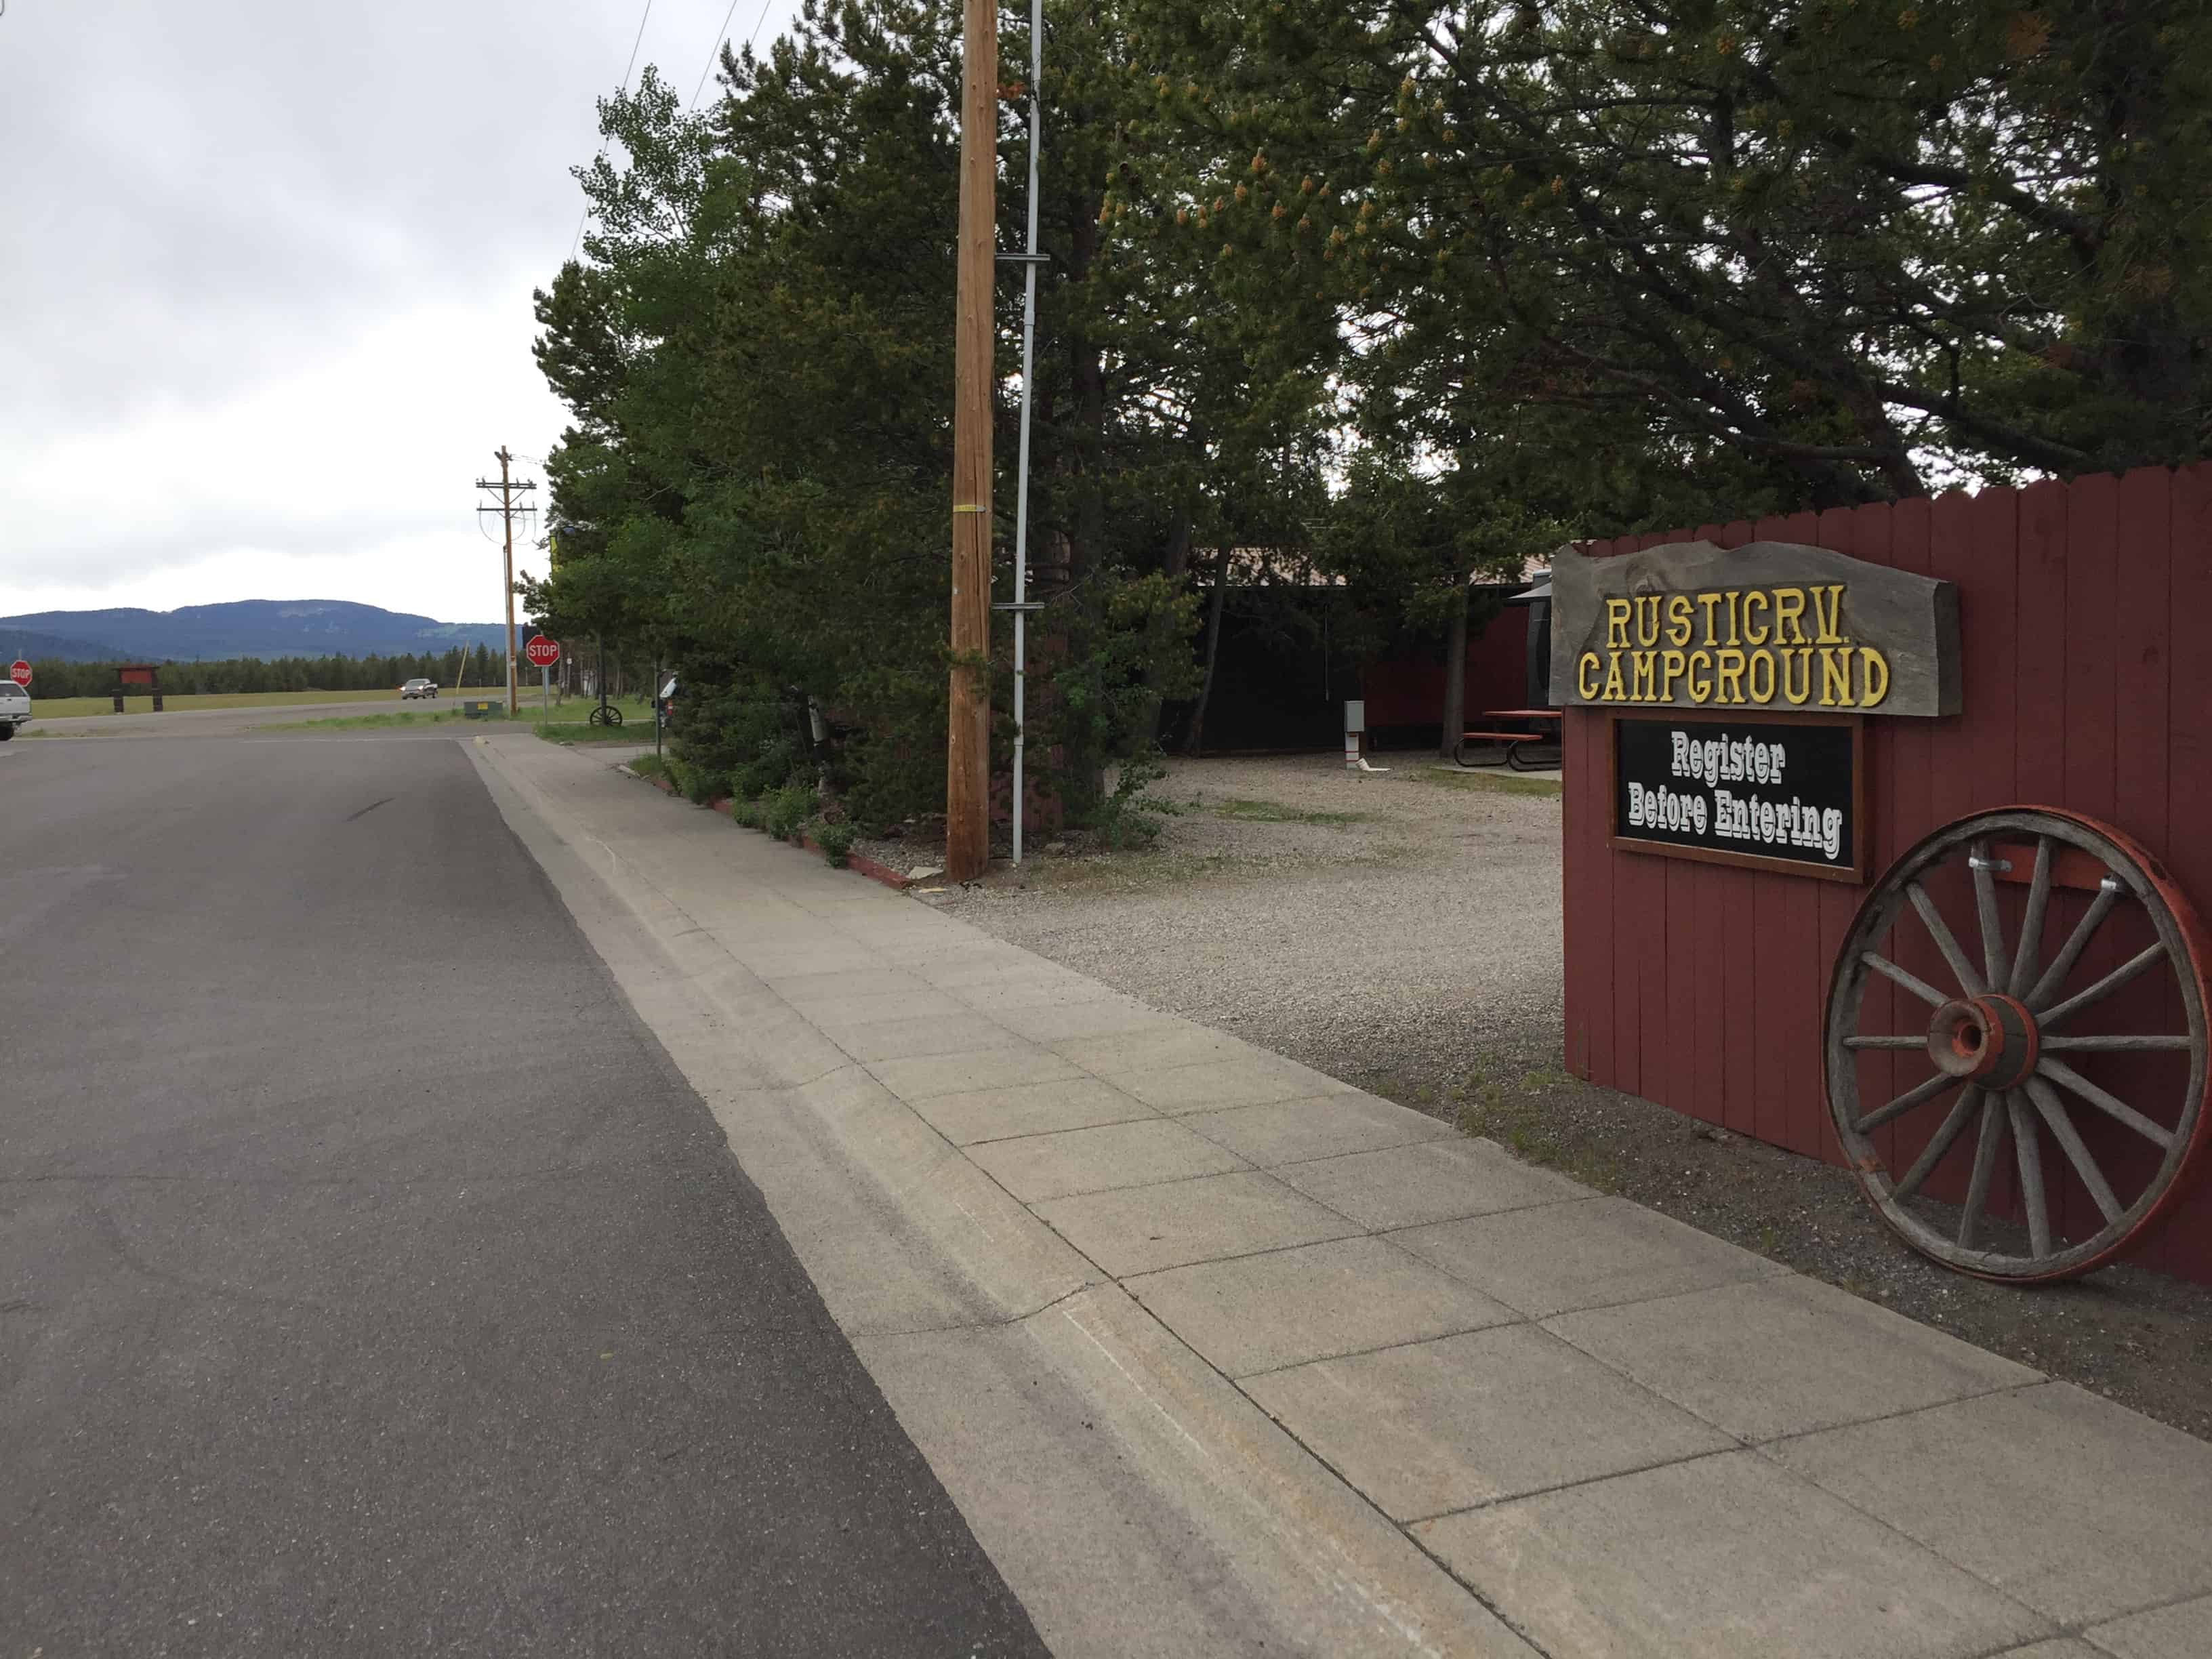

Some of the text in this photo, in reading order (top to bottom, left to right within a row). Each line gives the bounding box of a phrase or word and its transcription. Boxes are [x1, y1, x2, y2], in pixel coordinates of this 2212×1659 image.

[1605, 591, 1770, 649] RUSTIC
[12, 668, 30, 678] STOP
[529, 644, 556, 656] STOP
[1578, 647, 1889, 708] CAMPGROUND
[1671, 731, 1786, 788] Register
[1628, 782, 1843, 860] Before Entering
